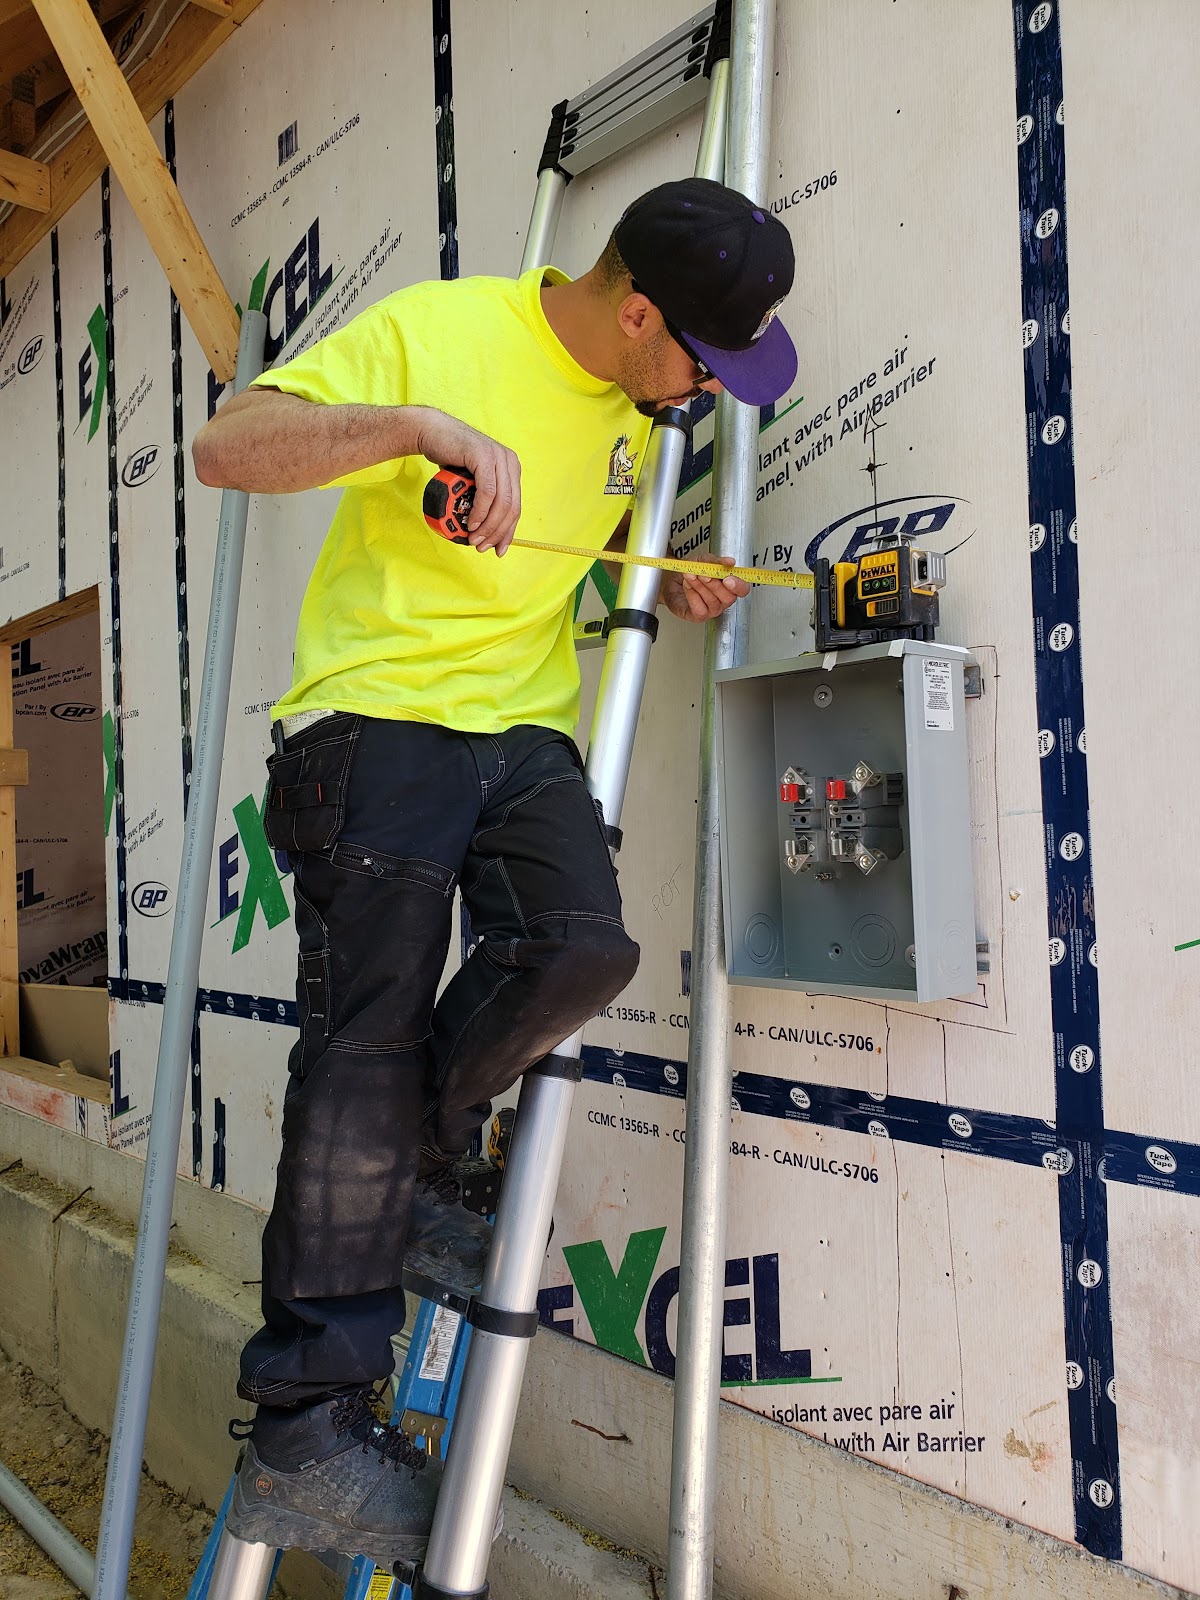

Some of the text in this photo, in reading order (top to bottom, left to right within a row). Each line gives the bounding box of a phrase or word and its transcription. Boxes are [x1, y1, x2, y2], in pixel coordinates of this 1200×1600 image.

[316, 113, 360, 157] CAN/ULC-S706
[769, 170, 838, 214] /ULC-S706
[315, 292, 340, 336] isolant
[340, 268, 358, 298] avec
[359, 243, 378, 275] pare
[379, 225, 391, 251] air
[319, 231, 403, 342] Panel with Air Barrier
[758, 346, 908, 473] lant avec pare air
[756, 357, 936, 502] anel with Air Barrier
[129, 449, 158, 483] BP
[670, 497, 712, 540] Panne
[671, 525, 711, 559] Insula
[774, 545, 793, 564] By
[47, 672, 61, 681] avec
[62, 668, 76, 677] pare
[62, 676, 72, 684] Air
[73, 671, 93, 680] Barrier
[60, 706, 97, 718] BP
[244, 703, 260, 715] CCMC
[138, 889, 169, 909] BP
[19, 930, 108, 984] ovaWrap
[616, 1008, 656, 1025] 13565-R
[768, 1025, 874, 1052] CAN/ULC-S706
[587, 1110, 617, 1128] CCMC
[619, 1117, 660, 1138] 13565-R
[729, 1141, 879, 1184] 84-R CAN/ULC-S706
[772, 1403, 828, 1424] isolant
[833, 1404, 873, 1423] avec
[879, 1401, 922, 1426] pare
[929, 1398, 955, 1420] air
[833, 1431, 875, 1452] with
[882, 1432, 910, 1452] Air
[917, 1431, 986, 1453] Barrier
